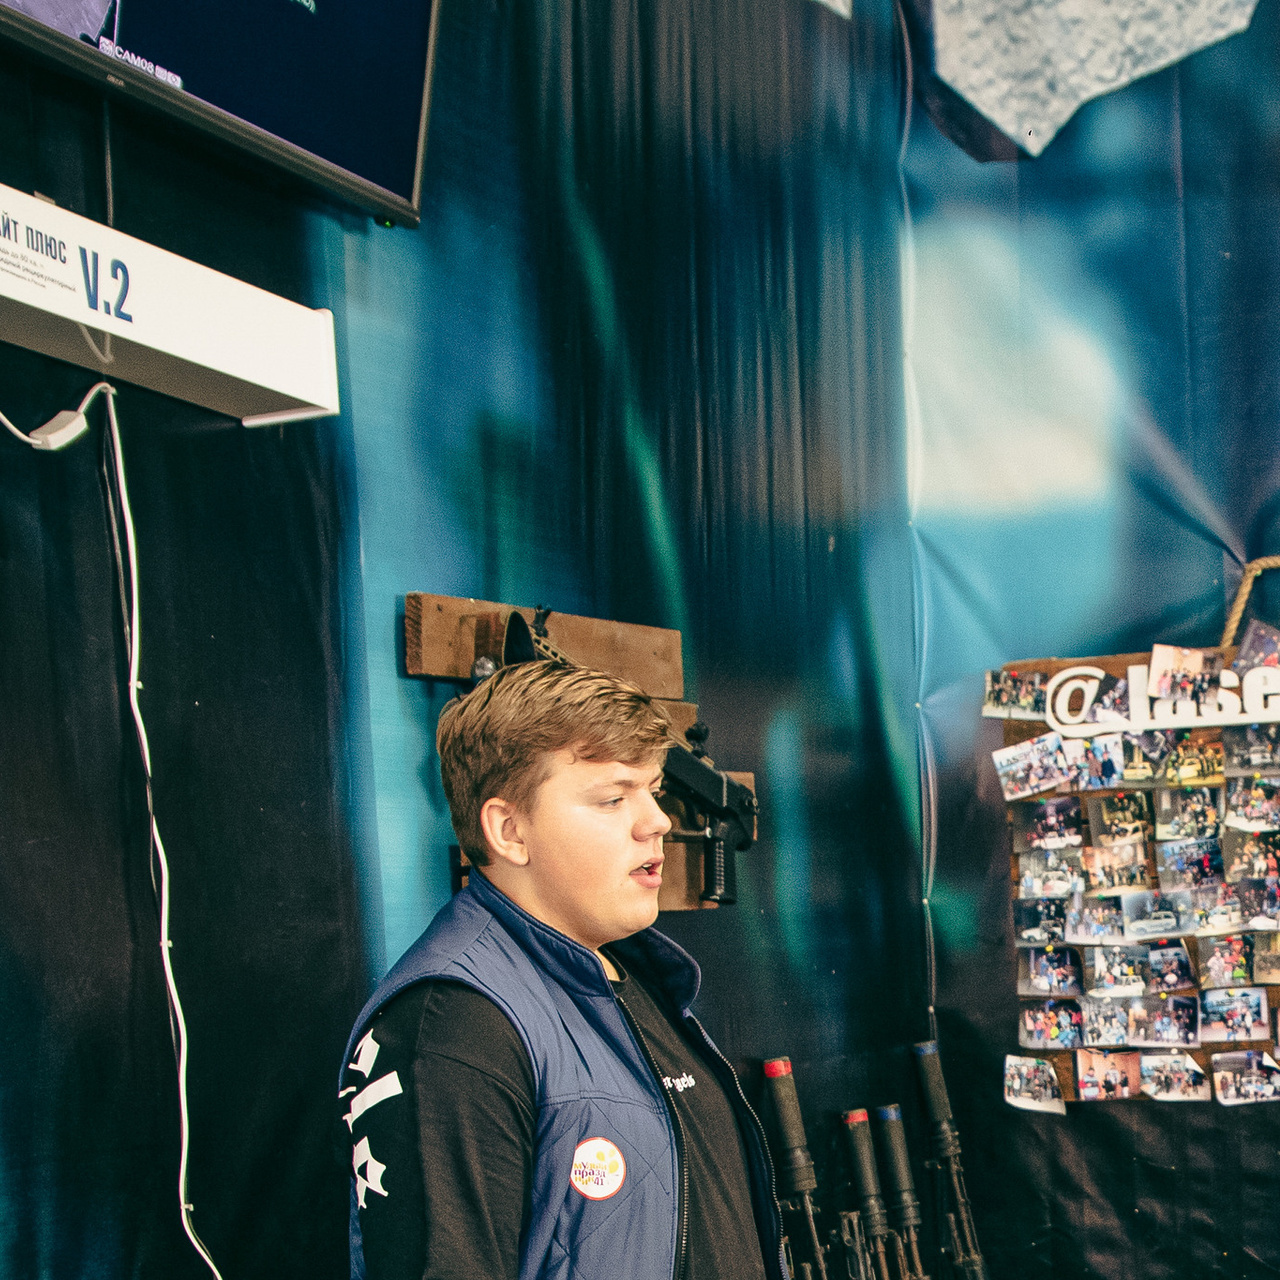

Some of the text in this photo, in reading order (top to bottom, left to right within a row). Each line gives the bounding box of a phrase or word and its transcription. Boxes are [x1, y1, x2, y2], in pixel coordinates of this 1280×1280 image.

[115, 45, 155, 75] CAM08
[0, 211, 19, 243] ЙТ
[26, 225, 67, 264] ПЛЮС
[78, 245, 133, 323] V.2
